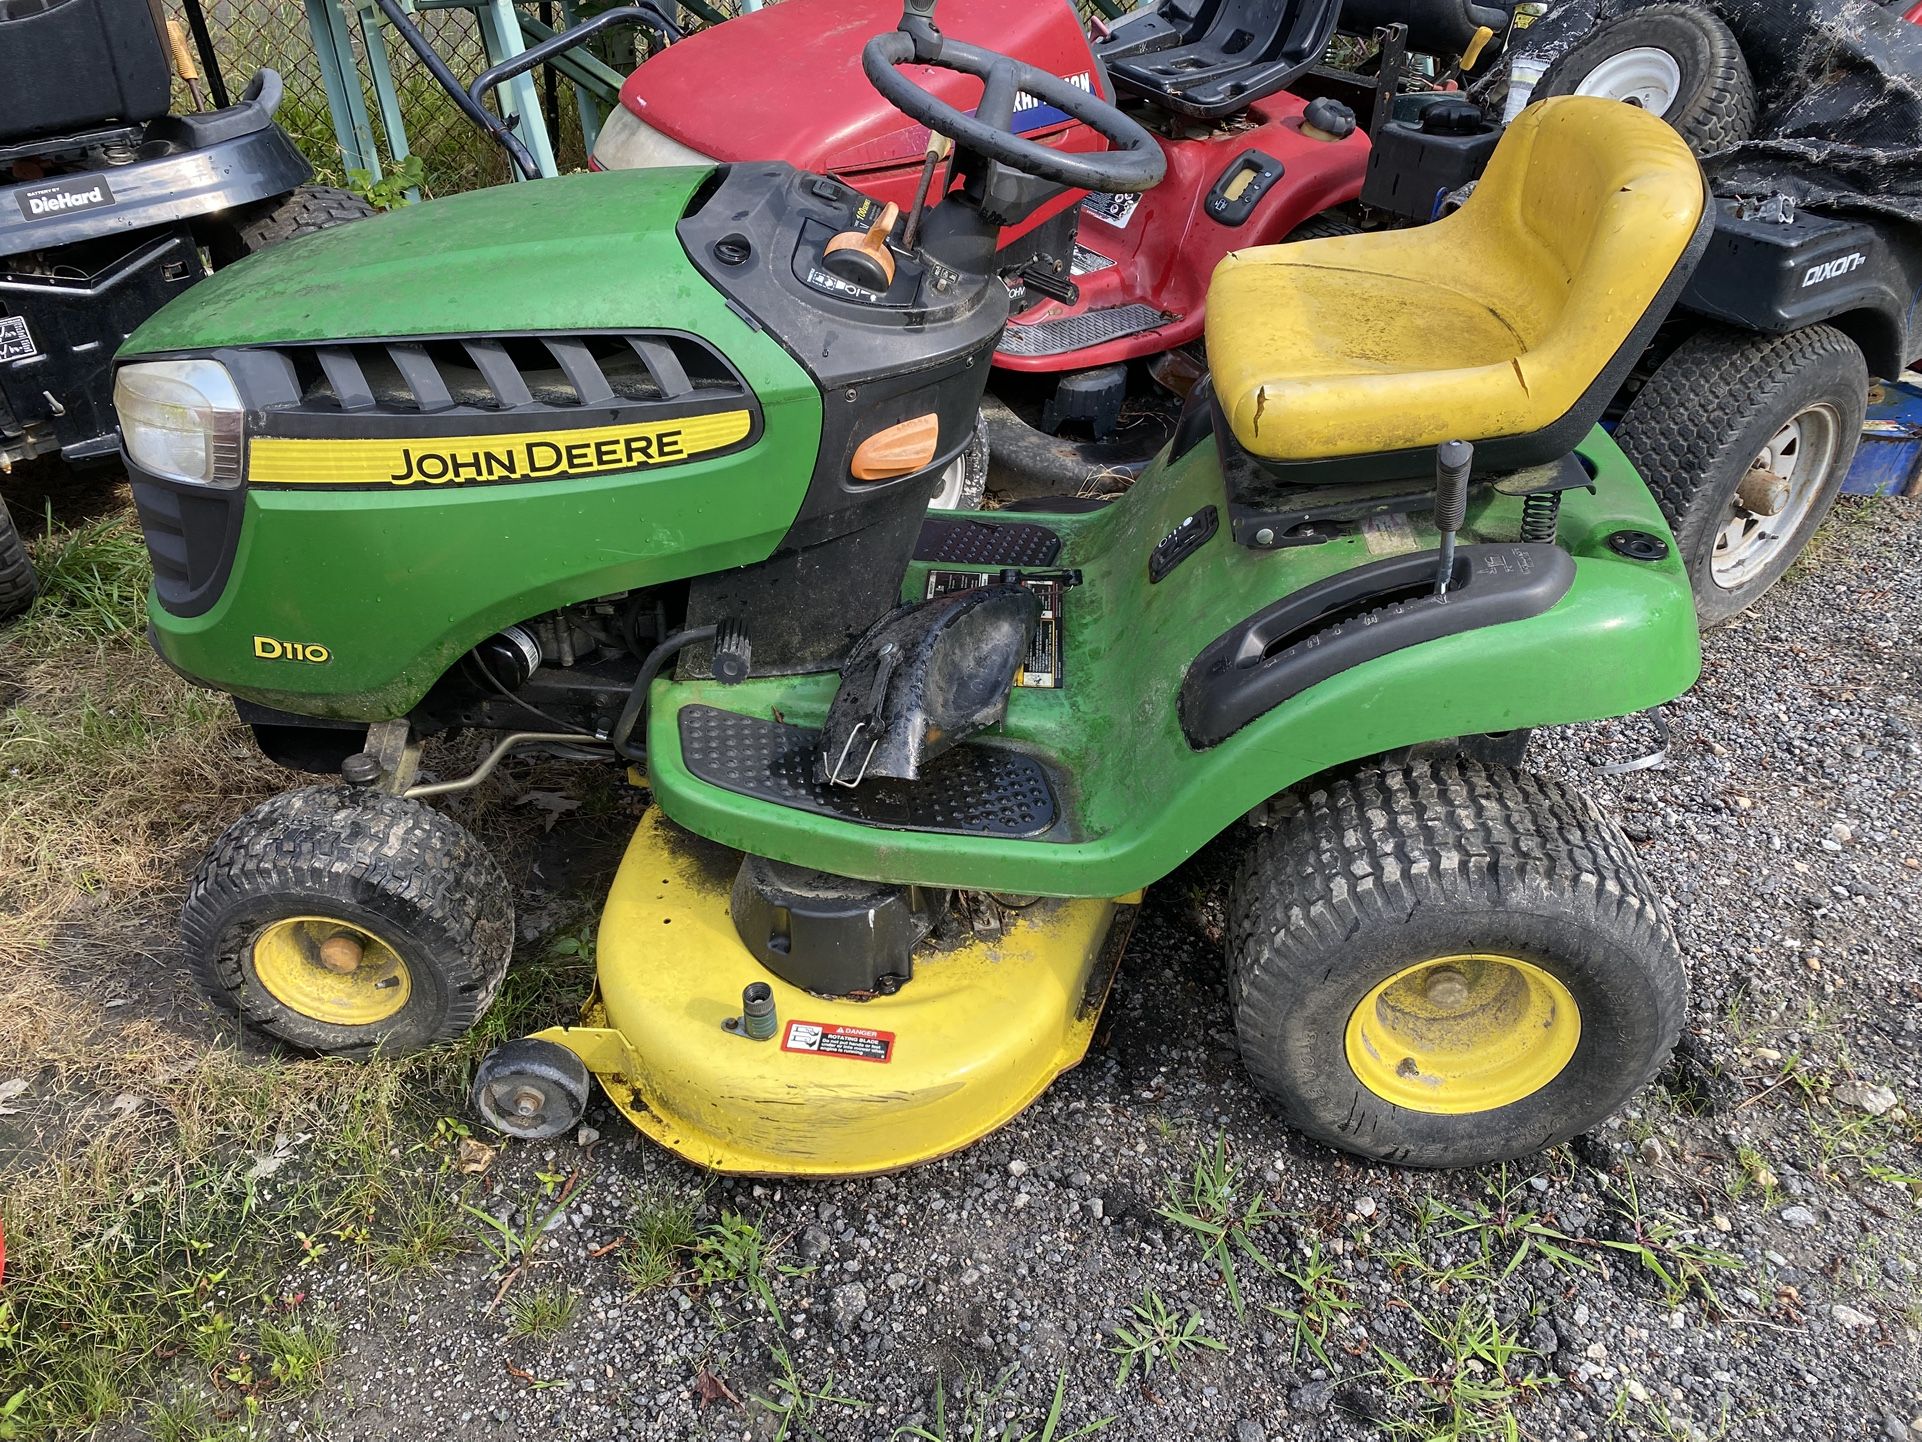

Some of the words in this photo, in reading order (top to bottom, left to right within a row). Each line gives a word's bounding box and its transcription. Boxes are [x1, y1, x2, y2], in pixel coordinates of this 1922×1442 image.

[29, 186, 104, 214] DieHard
[1801, 252, 1861, 288] DIXON
[1008, 286, 1026, 299] OHV
[390, 448, 515, 481] JOHN
[524, 429, 684, 473] DEERE
[253, 636, 329, 662] D110
[828, 1034, 858, 1042] ROTATING
[859, 1037, 879, 1045] BLADE
[845, 1028, 877, 1037] DANGER
